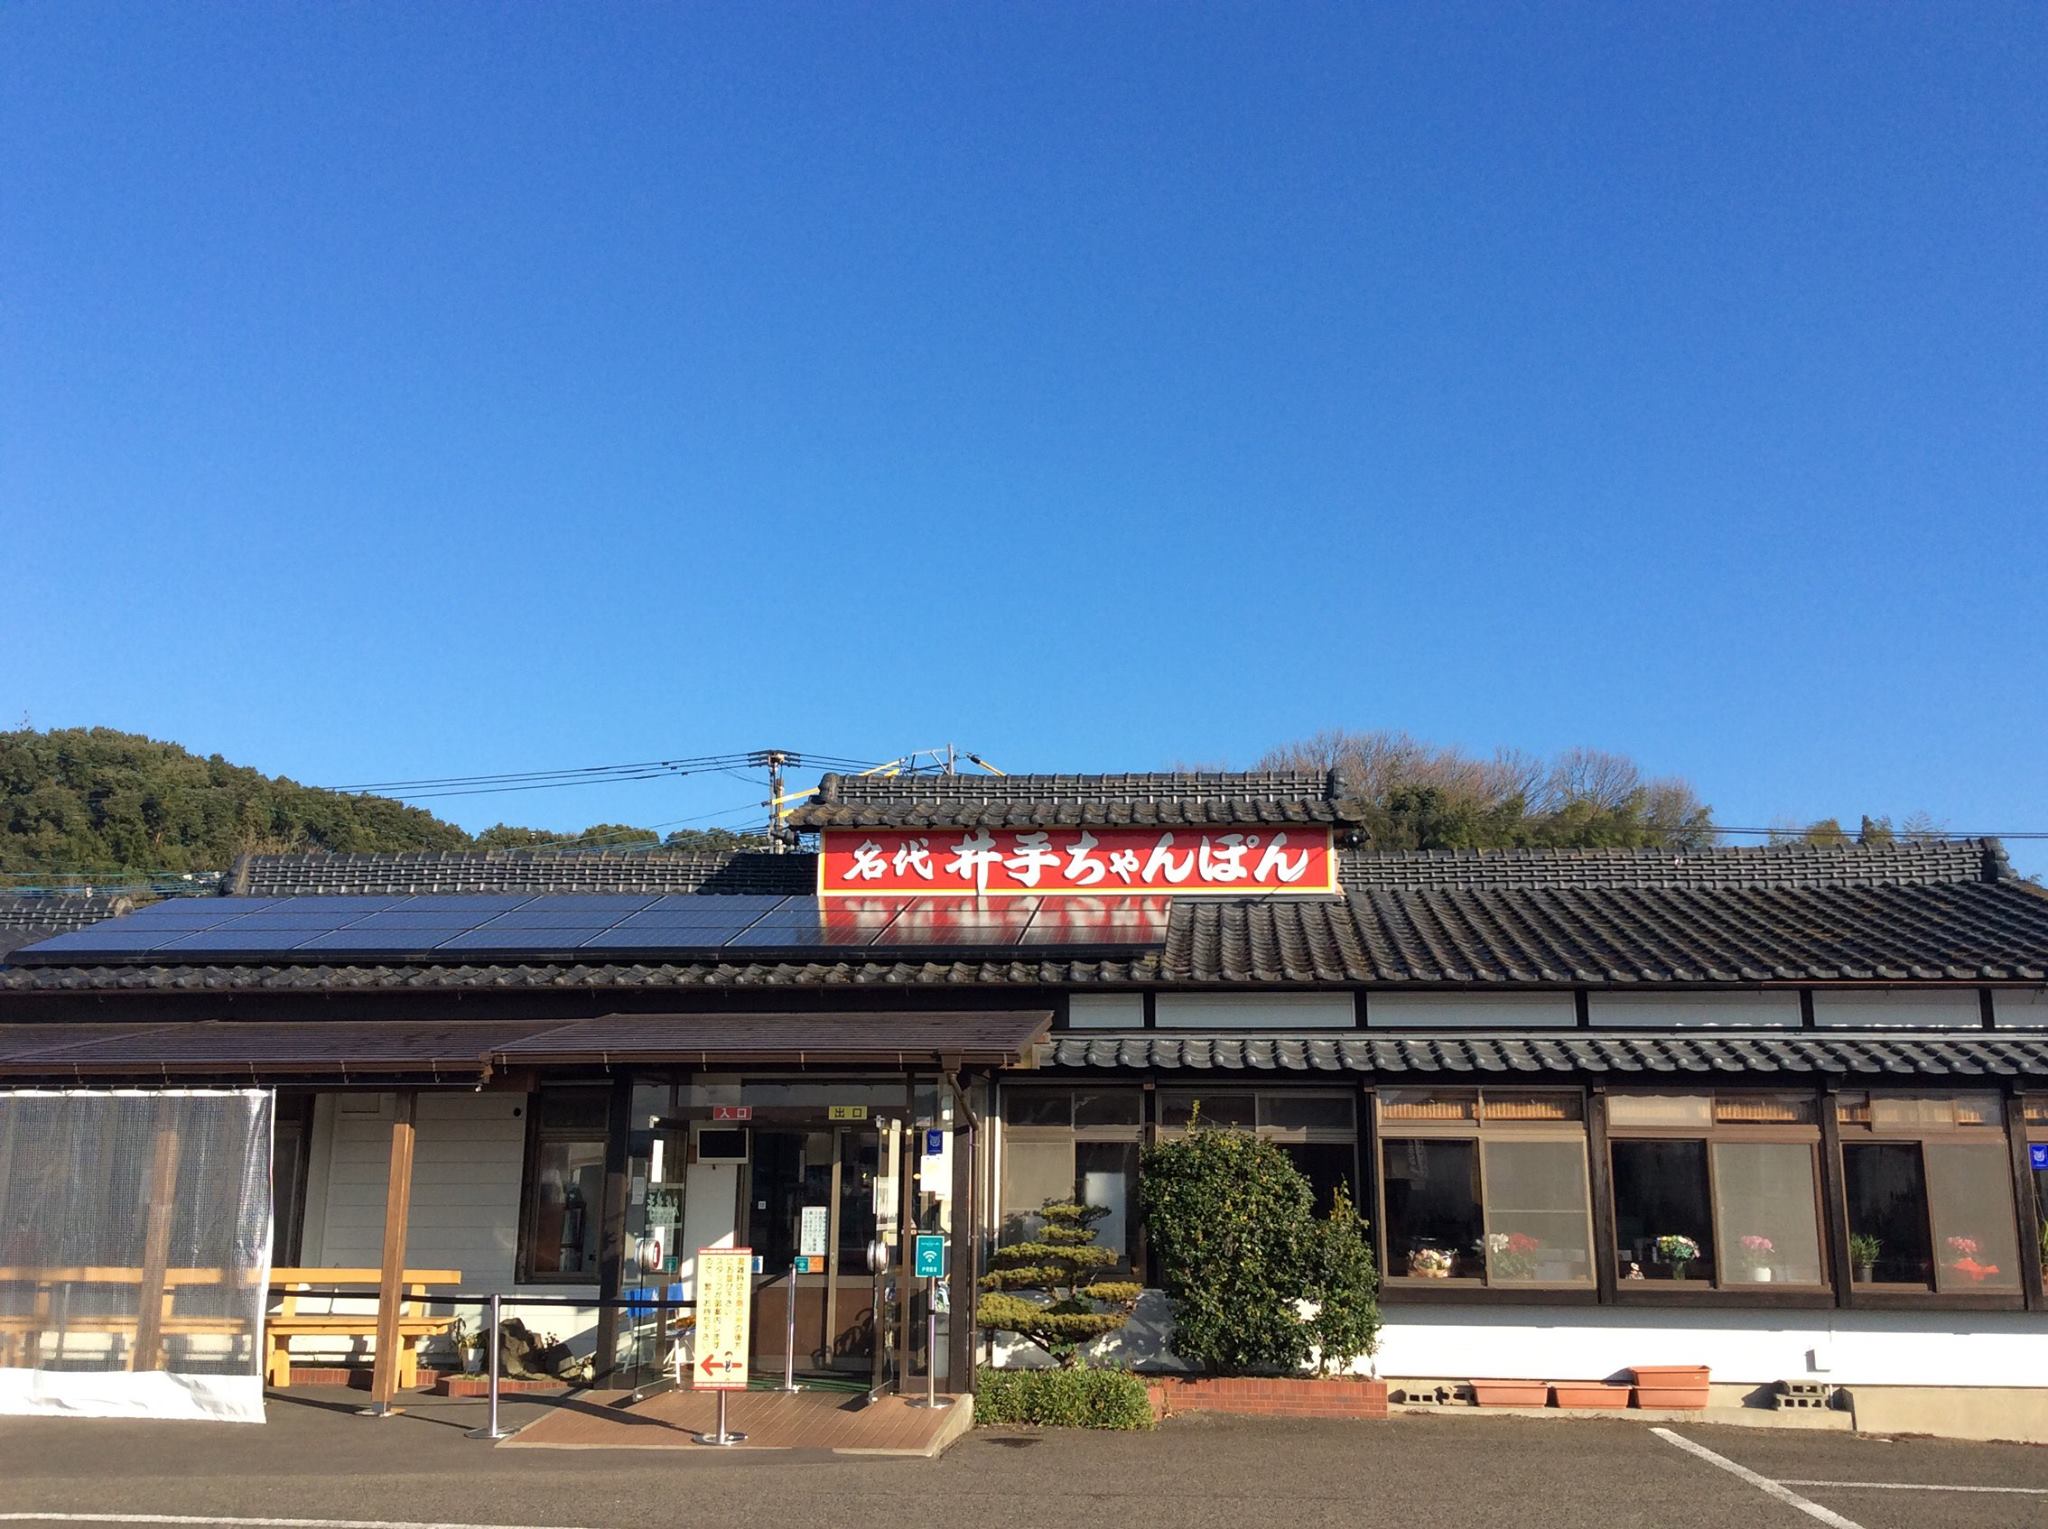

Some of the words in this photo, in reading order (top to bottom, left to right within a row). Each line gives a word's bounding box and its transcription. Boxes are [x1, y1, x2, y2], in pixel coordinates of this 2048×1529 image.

[843, 837, 933, 881] 名代
[944, 826, 1308, 896] 井手ちゃんぽん
[719, 1107, 747, 1119] 入口
[834, 1107, 862, 1119] 出口
